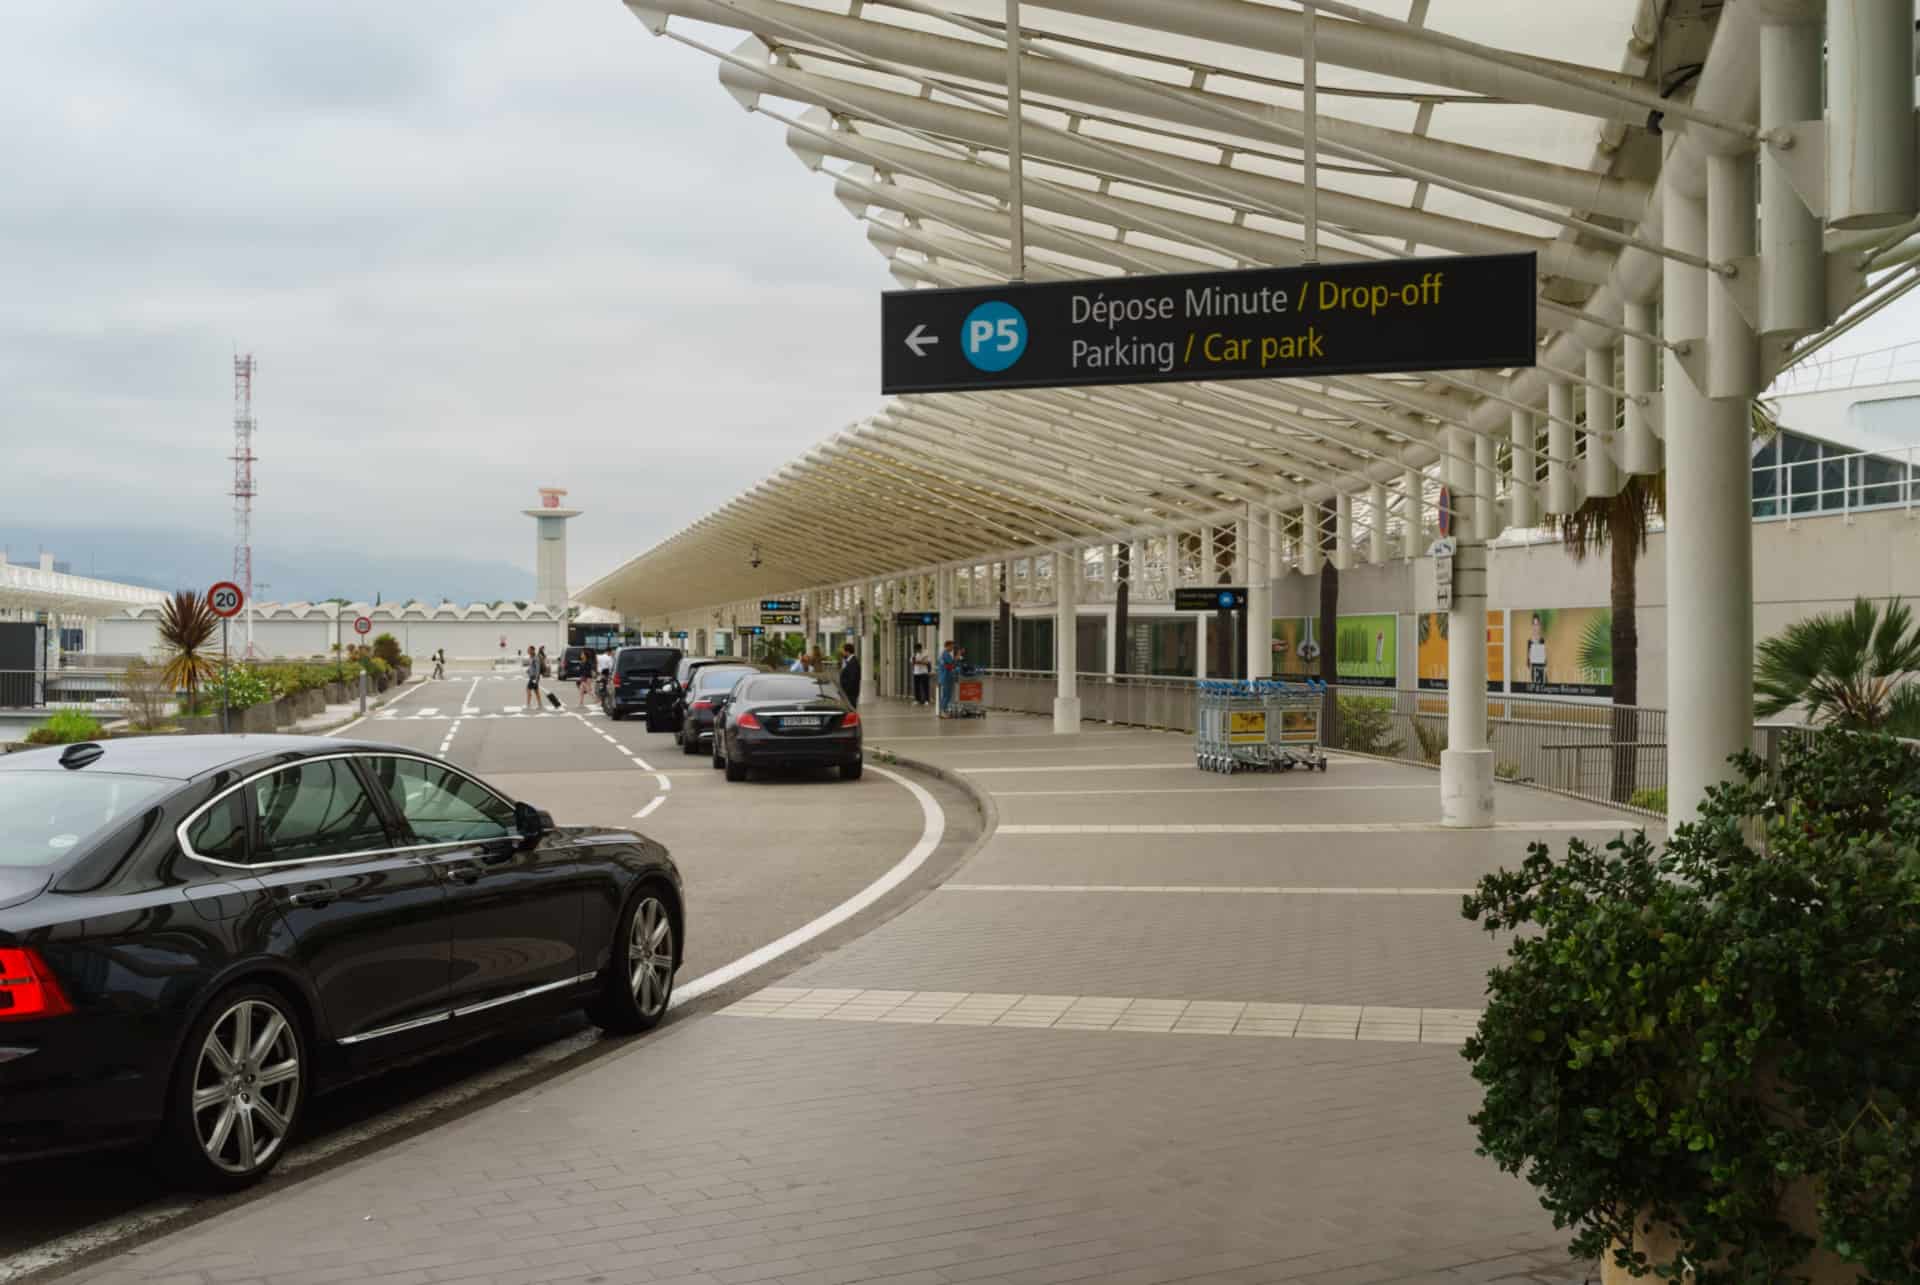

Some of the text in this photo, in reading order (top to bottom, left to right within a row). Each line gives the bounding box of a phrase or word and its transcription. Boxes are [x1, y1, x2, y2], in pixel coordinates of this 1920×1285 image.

[1071, 272, 1445, 331] Dépose Minute / Drop-off
[969, 317, 1019, 353] P5
[1071, 327, 1324, 373] Parking / Car park
[215, 592, 236, 607] 20
